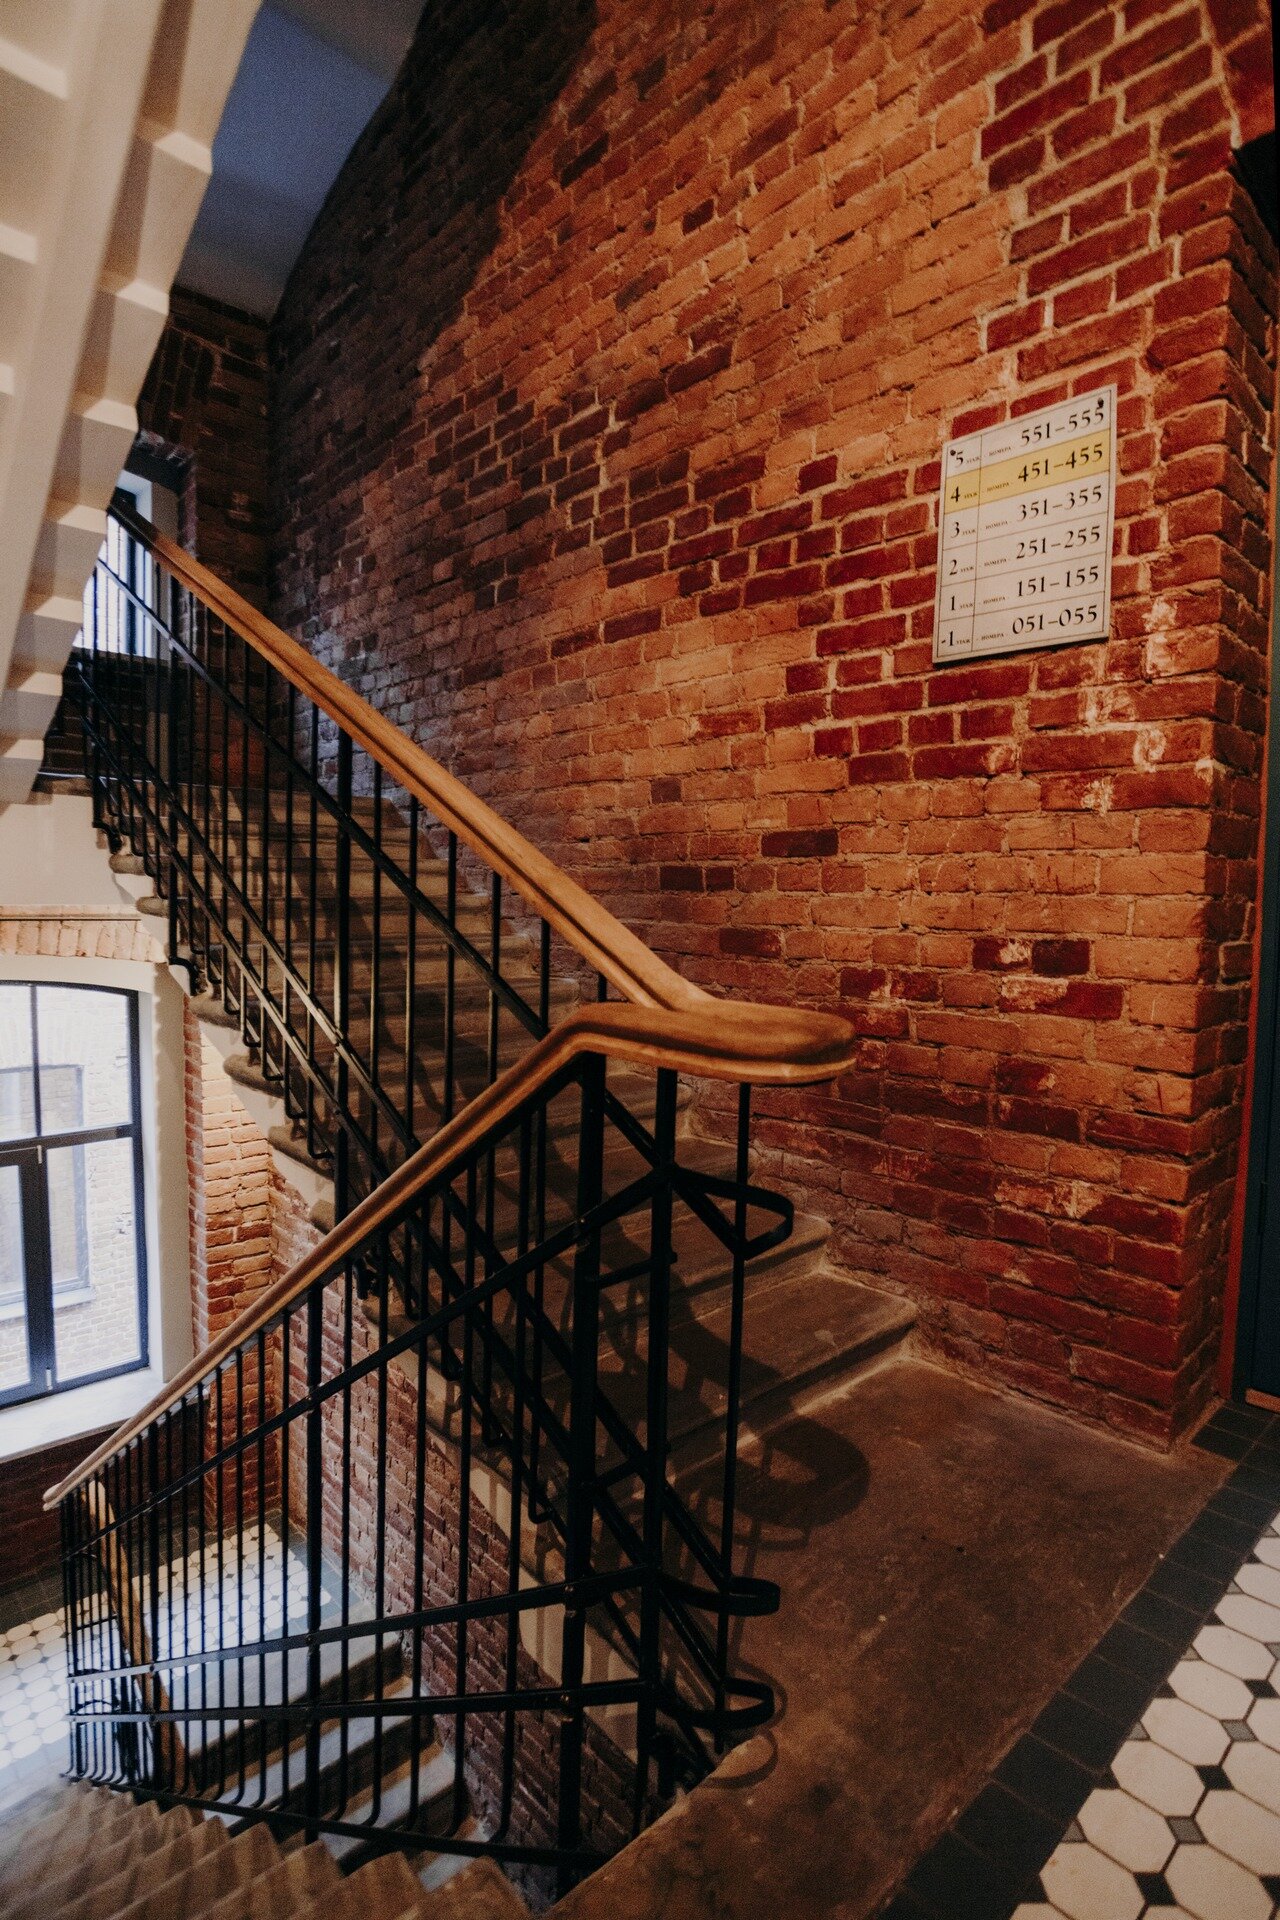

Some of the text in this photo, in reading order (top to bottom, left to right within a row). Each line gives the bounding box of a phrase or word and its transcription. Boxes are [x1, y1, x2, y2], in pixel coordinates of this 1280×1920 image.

[954, 451, 964, 468] 5
[1020, 407, 1104, 447] 551-555
[950, 486, 961, 503] 4
[1018, 443, 1103, 483] 451-455
[951, 521, 960, 539] 3
[1016, 485, 1102, 522] 351-355
[949, 559, 958, 576] 2
[1016, 525, 1100, 559] 251-255
[950, 595, 956, 611] 1
[1017, 565, 1099, 597] 151-155
[941, 630, 954, 646] -1
[1012, 604, 1098, 635] 051-055
